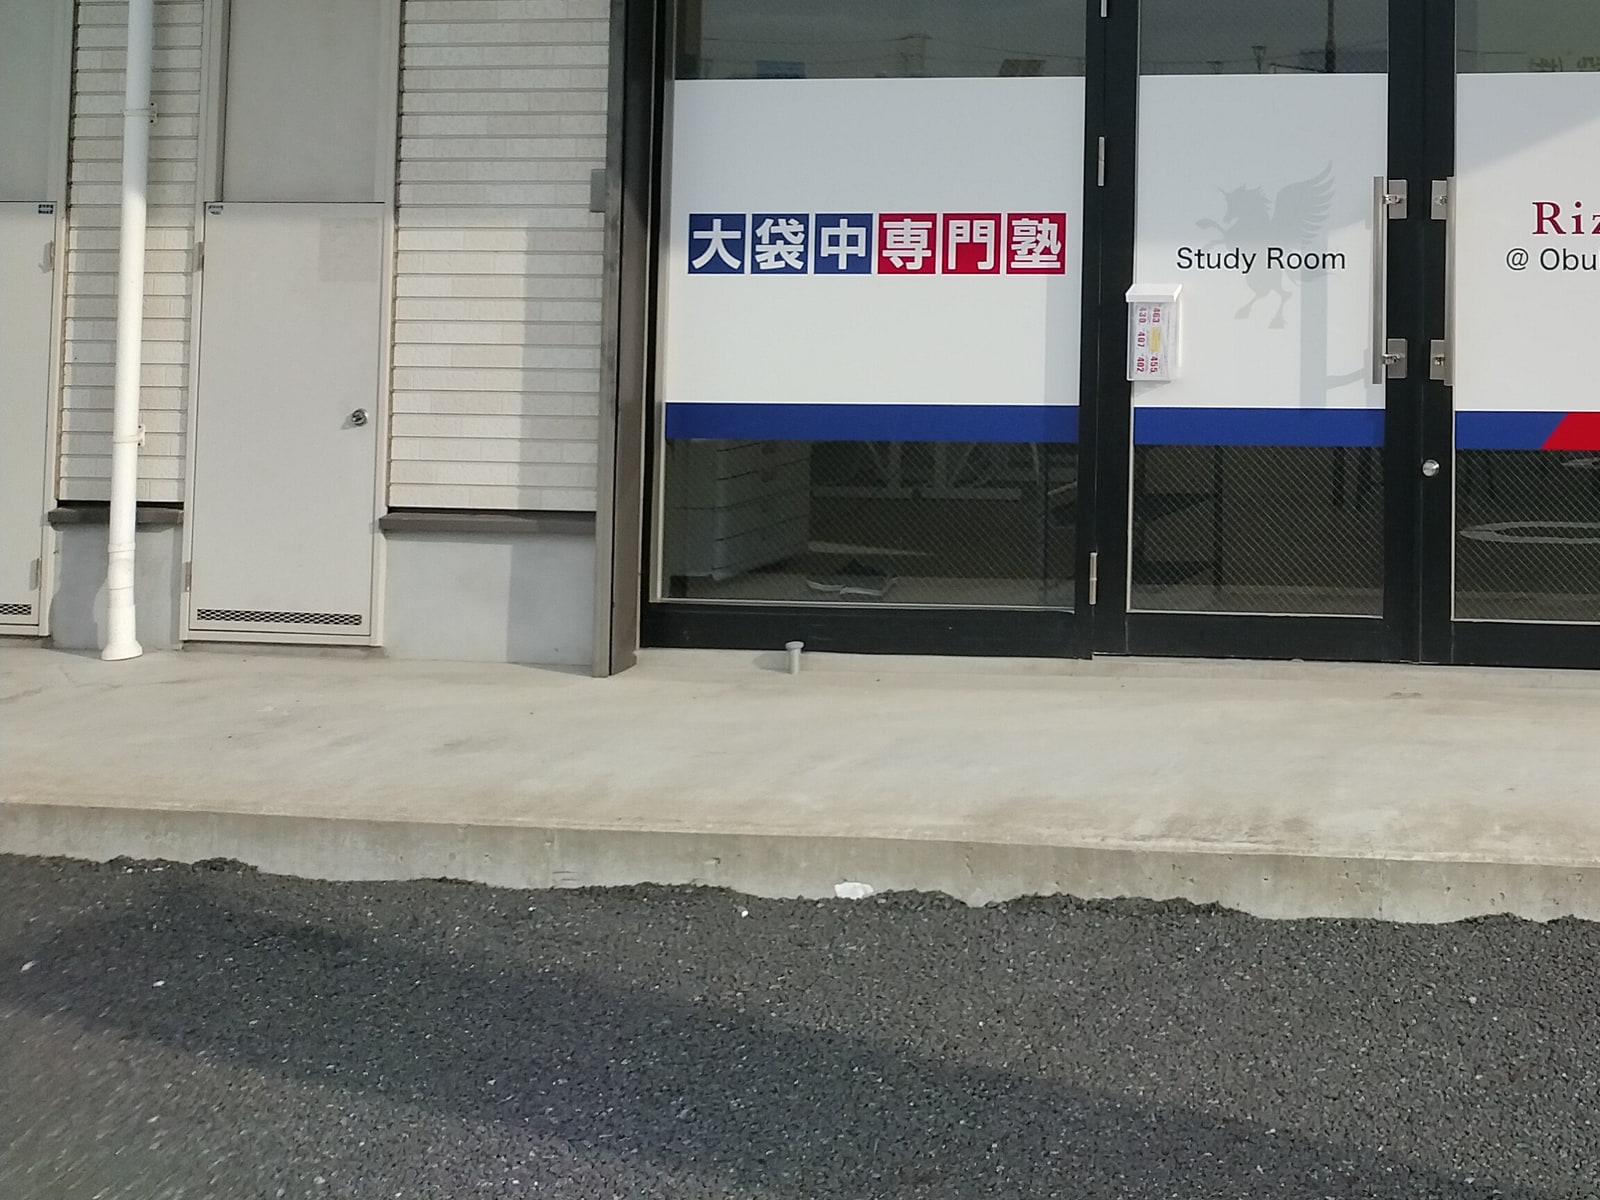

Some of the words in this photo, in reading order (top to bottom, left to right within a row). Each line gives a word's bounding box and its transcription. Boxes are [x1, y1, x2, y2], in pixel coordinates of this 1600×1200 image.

[689, 217, 1064, 273] 大袋中専門塾
[1176, 246, 1257, 274] Study
[1267, 247, 1345, 270] Room
[1506, 248, 1529, 271] @
